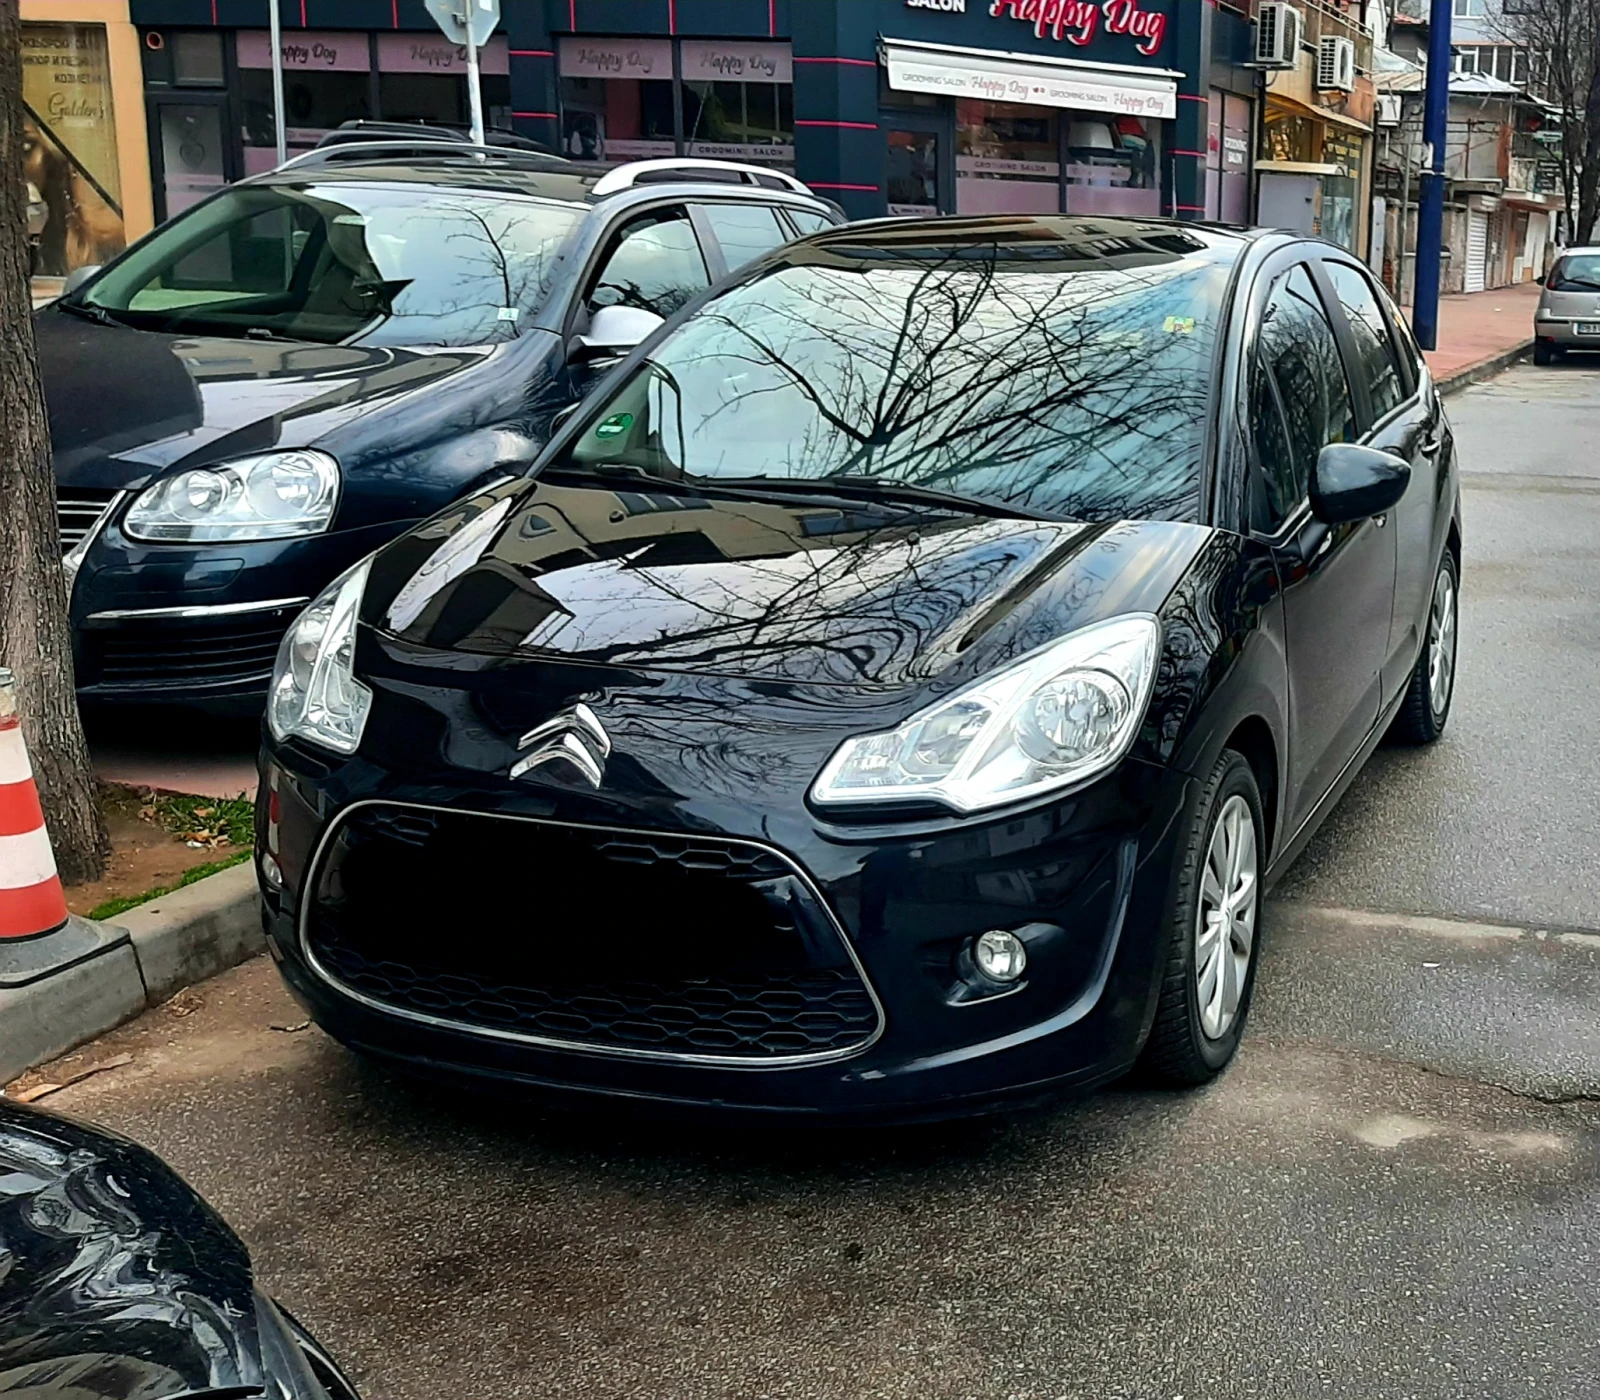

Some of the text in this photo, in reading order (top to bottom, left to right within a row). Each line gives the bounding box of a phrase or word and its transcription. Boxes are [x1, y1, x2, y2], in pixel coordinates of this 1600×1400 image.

[906, 0, 966, 13] SALON
[989, 0, 1166, 55] Happy Dog
[269, 42, 337, 65] appy Dog
[410, 43, 453, 67] Happy
[578, 48, 622, 72] Happy
[700, 51, 777, 77] Happy Dog
[970, 76, 1006, 98] Happy
[1008, 80, 1029, 101] Dog
[1113, 92, 1144, 114] Happy
[1146, 96, 1164, 116] Dog
